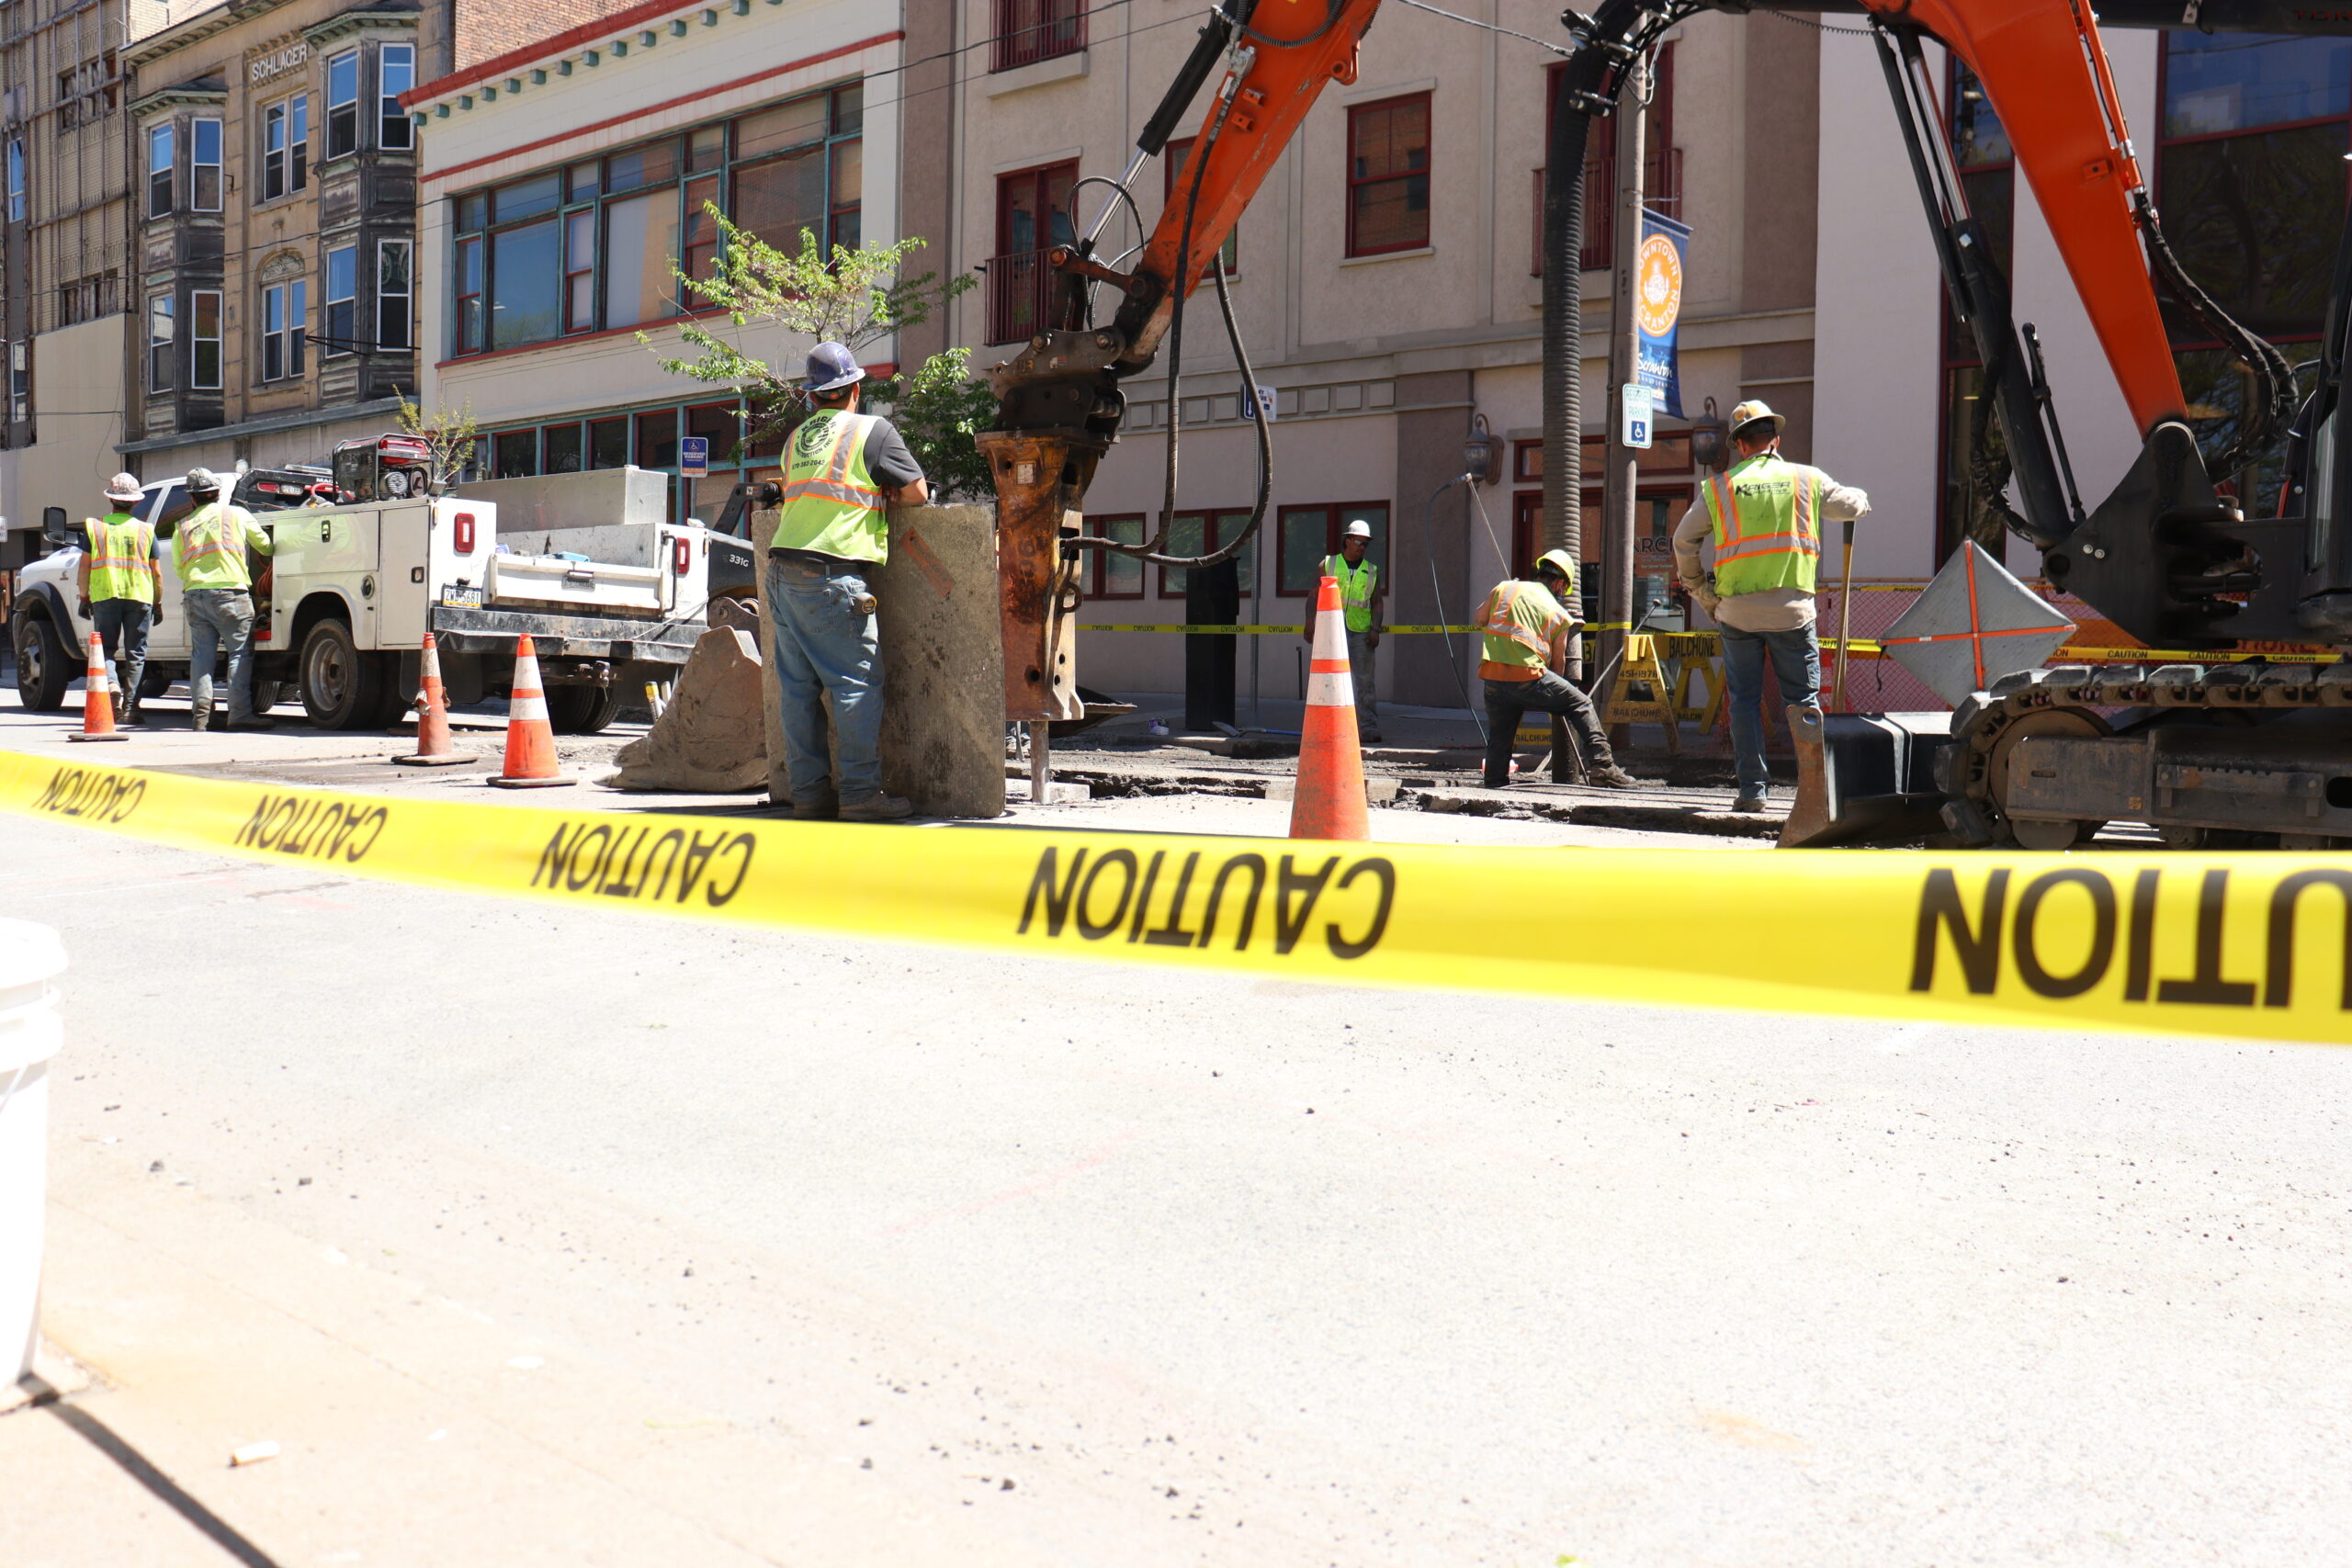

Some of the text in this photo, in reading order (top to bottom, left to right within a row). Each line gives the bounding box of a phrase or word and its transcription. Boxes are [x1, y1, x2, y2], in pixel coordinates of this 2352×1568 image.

[252, 43, 308, 81] SCHLAGER
[1638, 242, 1679, 276] OWNTOWN
[1736, 481, 1791, 496] KRIGER
[729, 554, 749, 568] 331G
[1668, 634, 1715, 658] BALCHUNE
[1817, 638, 1851, 649] CAUTN
[2107, 649, 2148, 660] CAUTION
[2188, 650, 2231, 661] CAUTION
[29, 767, 2352, 1010] CAUTION CAUTION CAUTION CAUTION UTION
